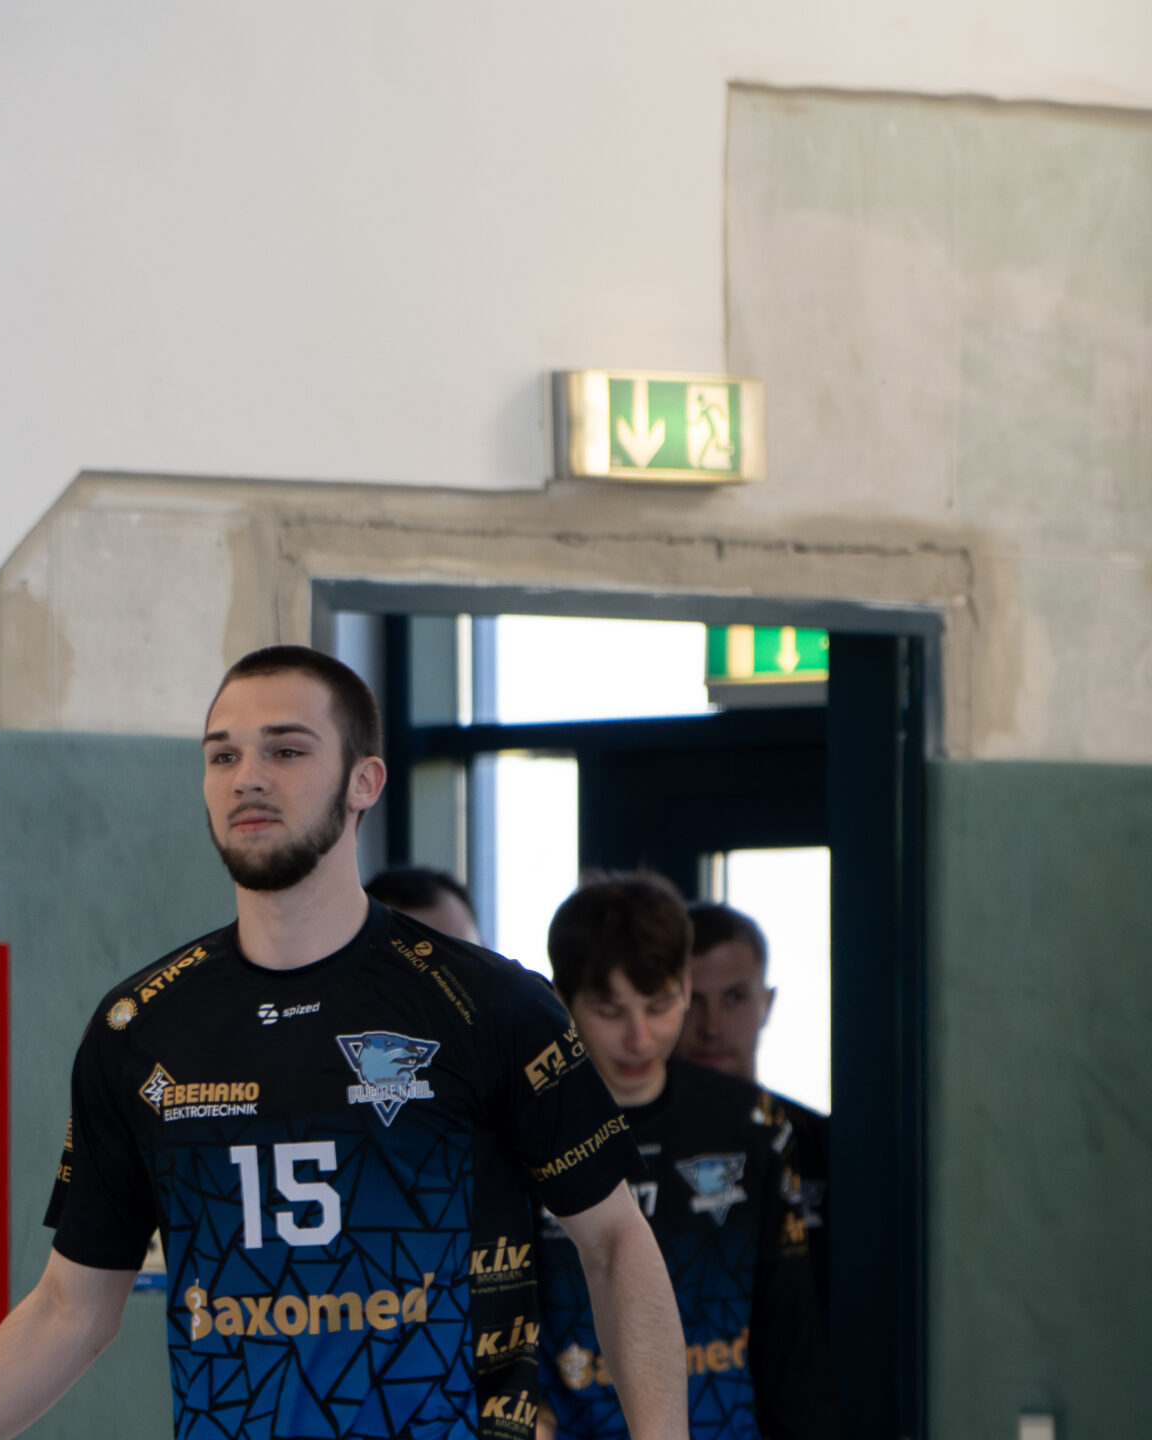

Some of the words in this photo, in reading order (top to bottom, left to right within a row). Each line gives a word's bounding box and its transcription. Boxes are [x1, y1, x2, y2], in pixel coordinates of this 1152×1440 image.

[390, 938, 429, 973] ZURICH
[140, 946, 208, 1003] ATHOS
[282, 1002, 321, 1018] spized
[162, 1082, 260, 1107] EBEHAKO
[163, 1103, 258, 1122] ELEKTROTECHNIK
[229, 1141, 342, 1249] 15
[184, 1272, 436, 1341] Saxomed
